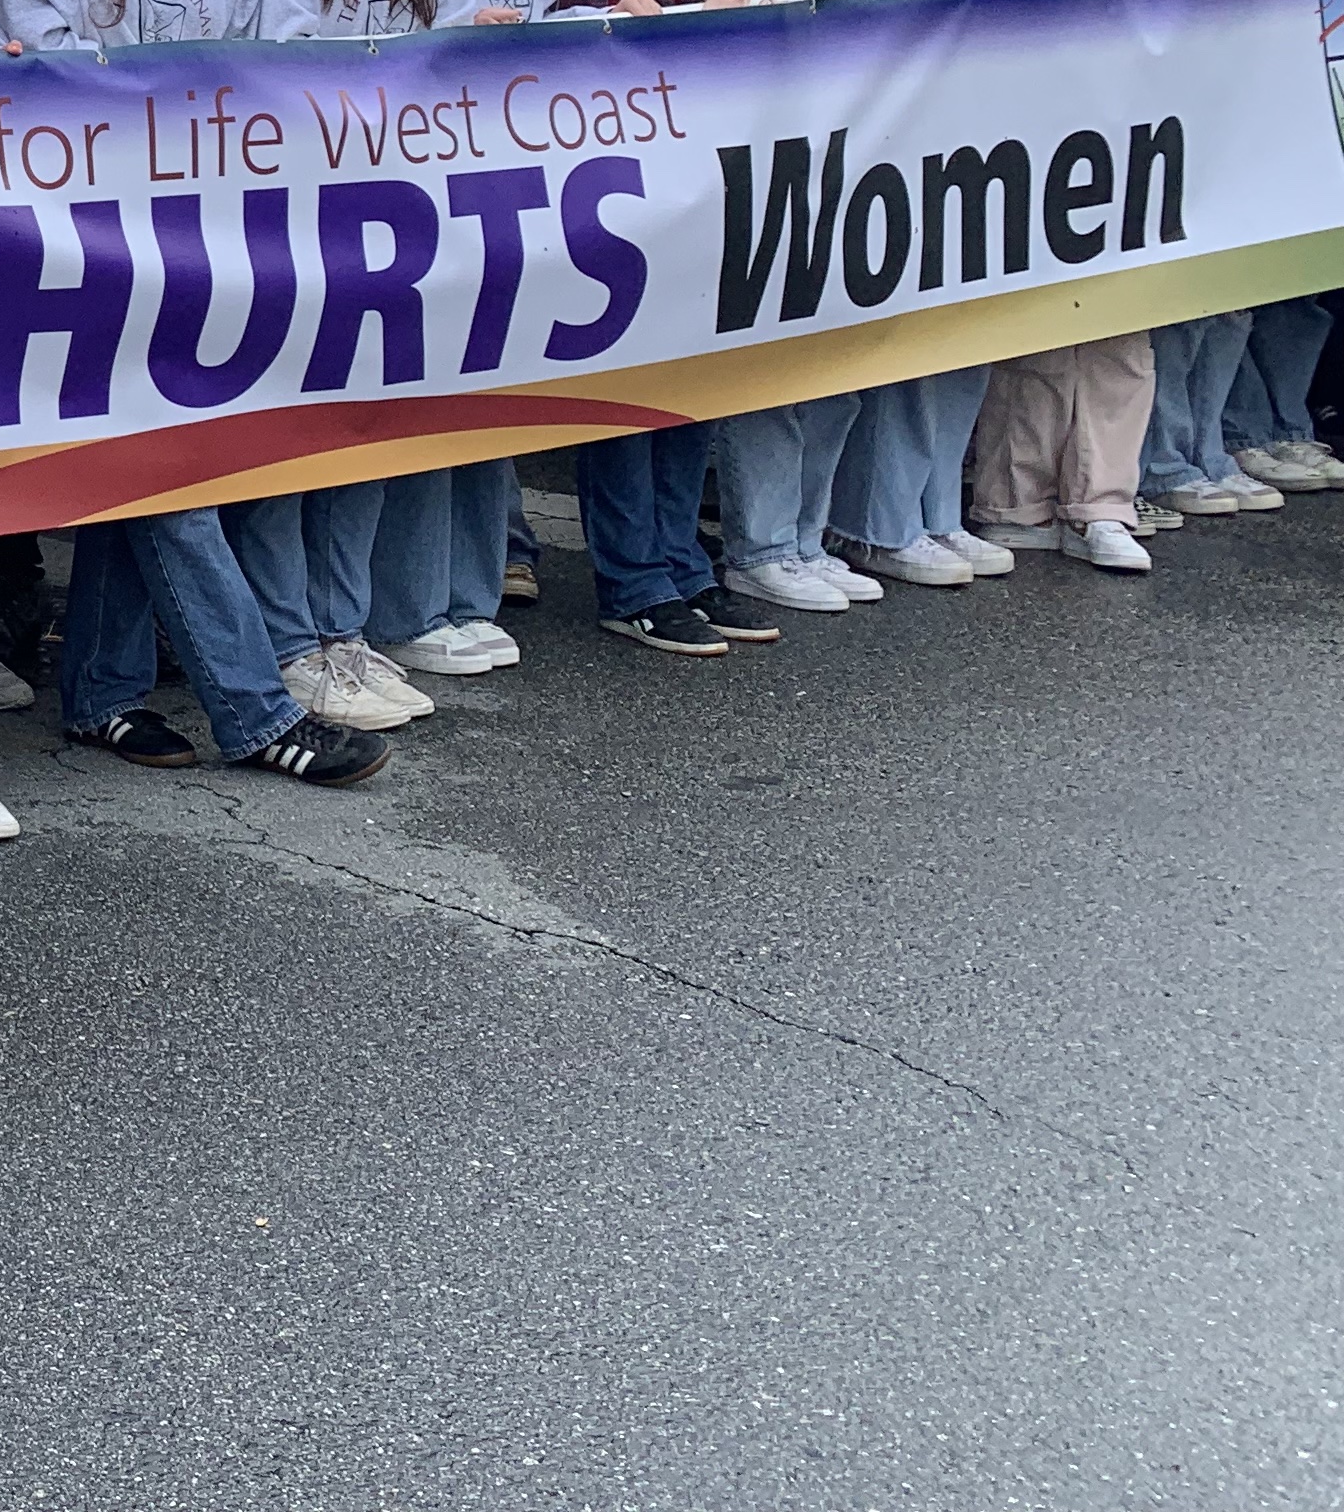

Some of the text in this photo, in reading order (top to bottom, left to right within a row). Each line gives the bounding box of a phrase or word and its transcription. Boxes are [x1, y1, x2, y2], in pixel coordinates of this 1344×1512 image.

[147, 85, 286, 182] Life
[312, 86, 486, 171] West
[505, 70, 687, 152] Coast
[715, 115, 1188, 335] Women
